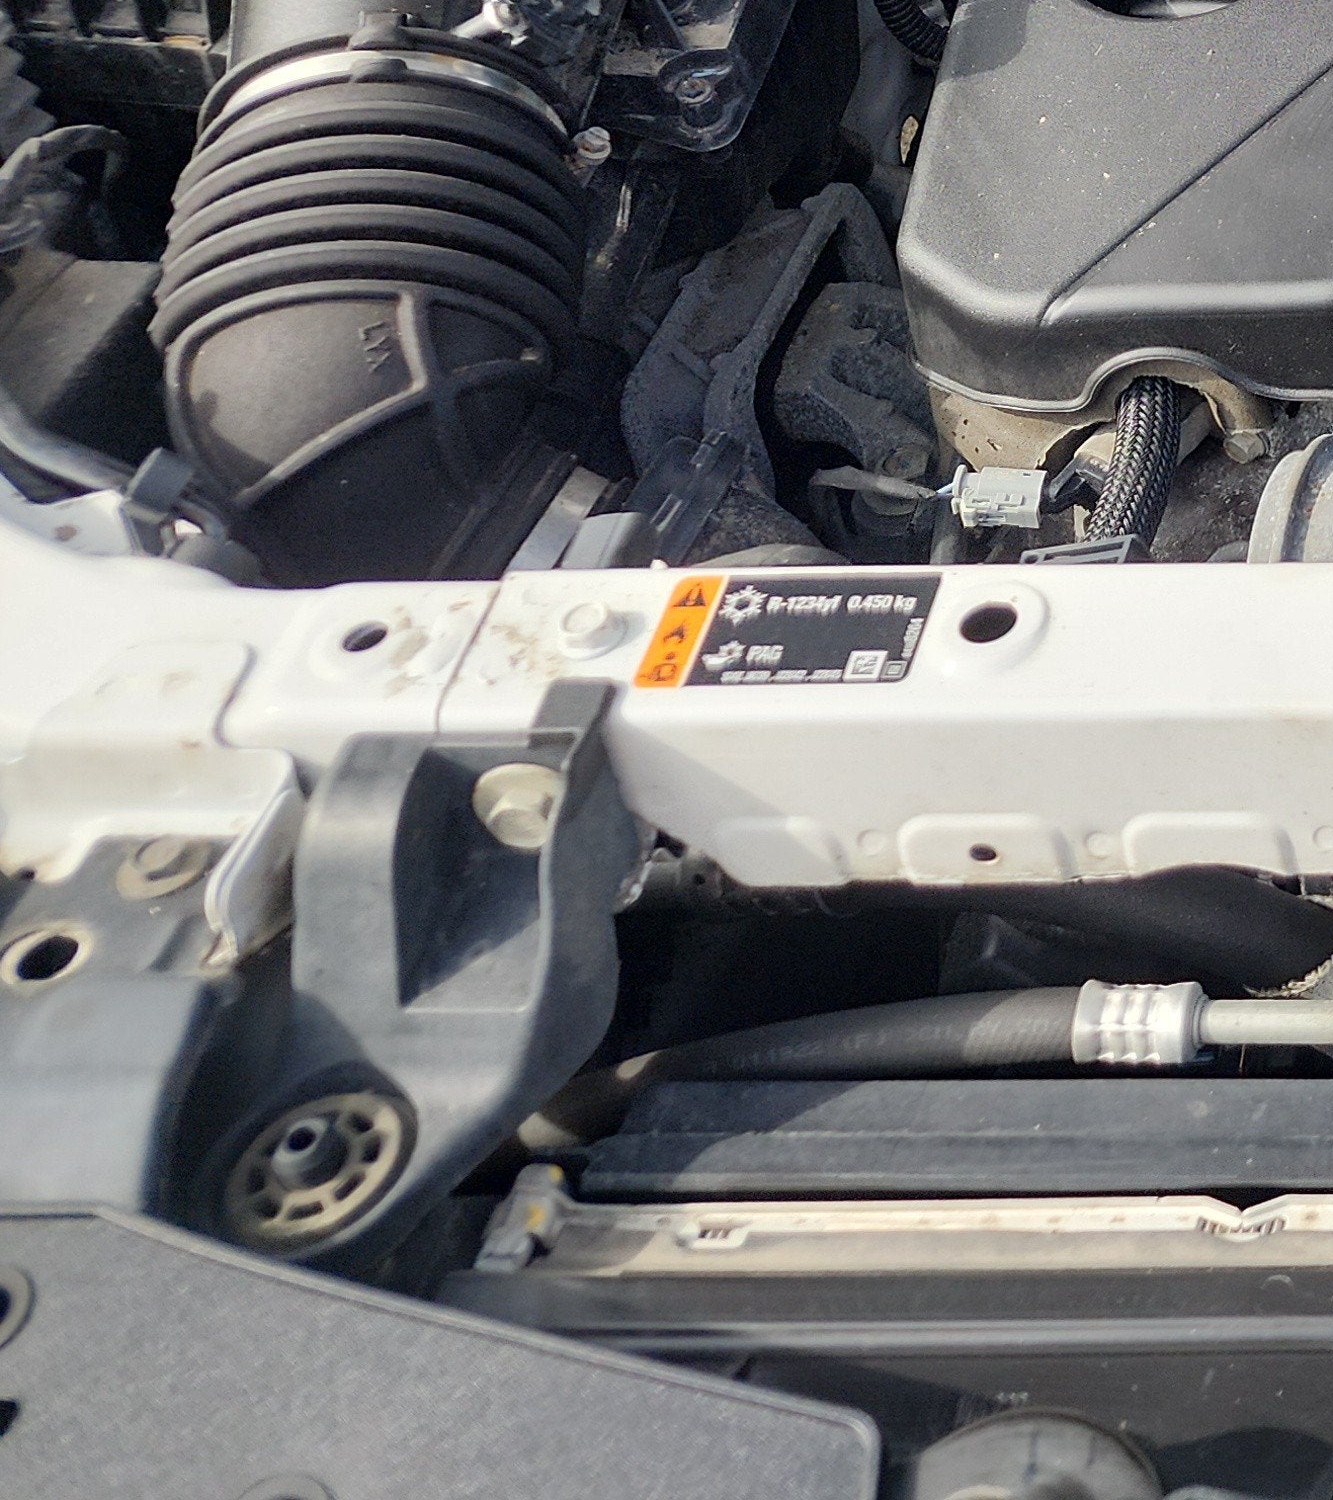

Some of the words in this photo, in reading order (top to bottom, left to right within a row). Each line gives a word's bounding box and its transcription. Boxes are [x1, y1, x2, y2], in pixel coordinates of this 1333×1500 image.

[846, 595, 894, 613] 0.450
[894, 595, 918, 614] kg
[745, 644, 784, 665] PAG
